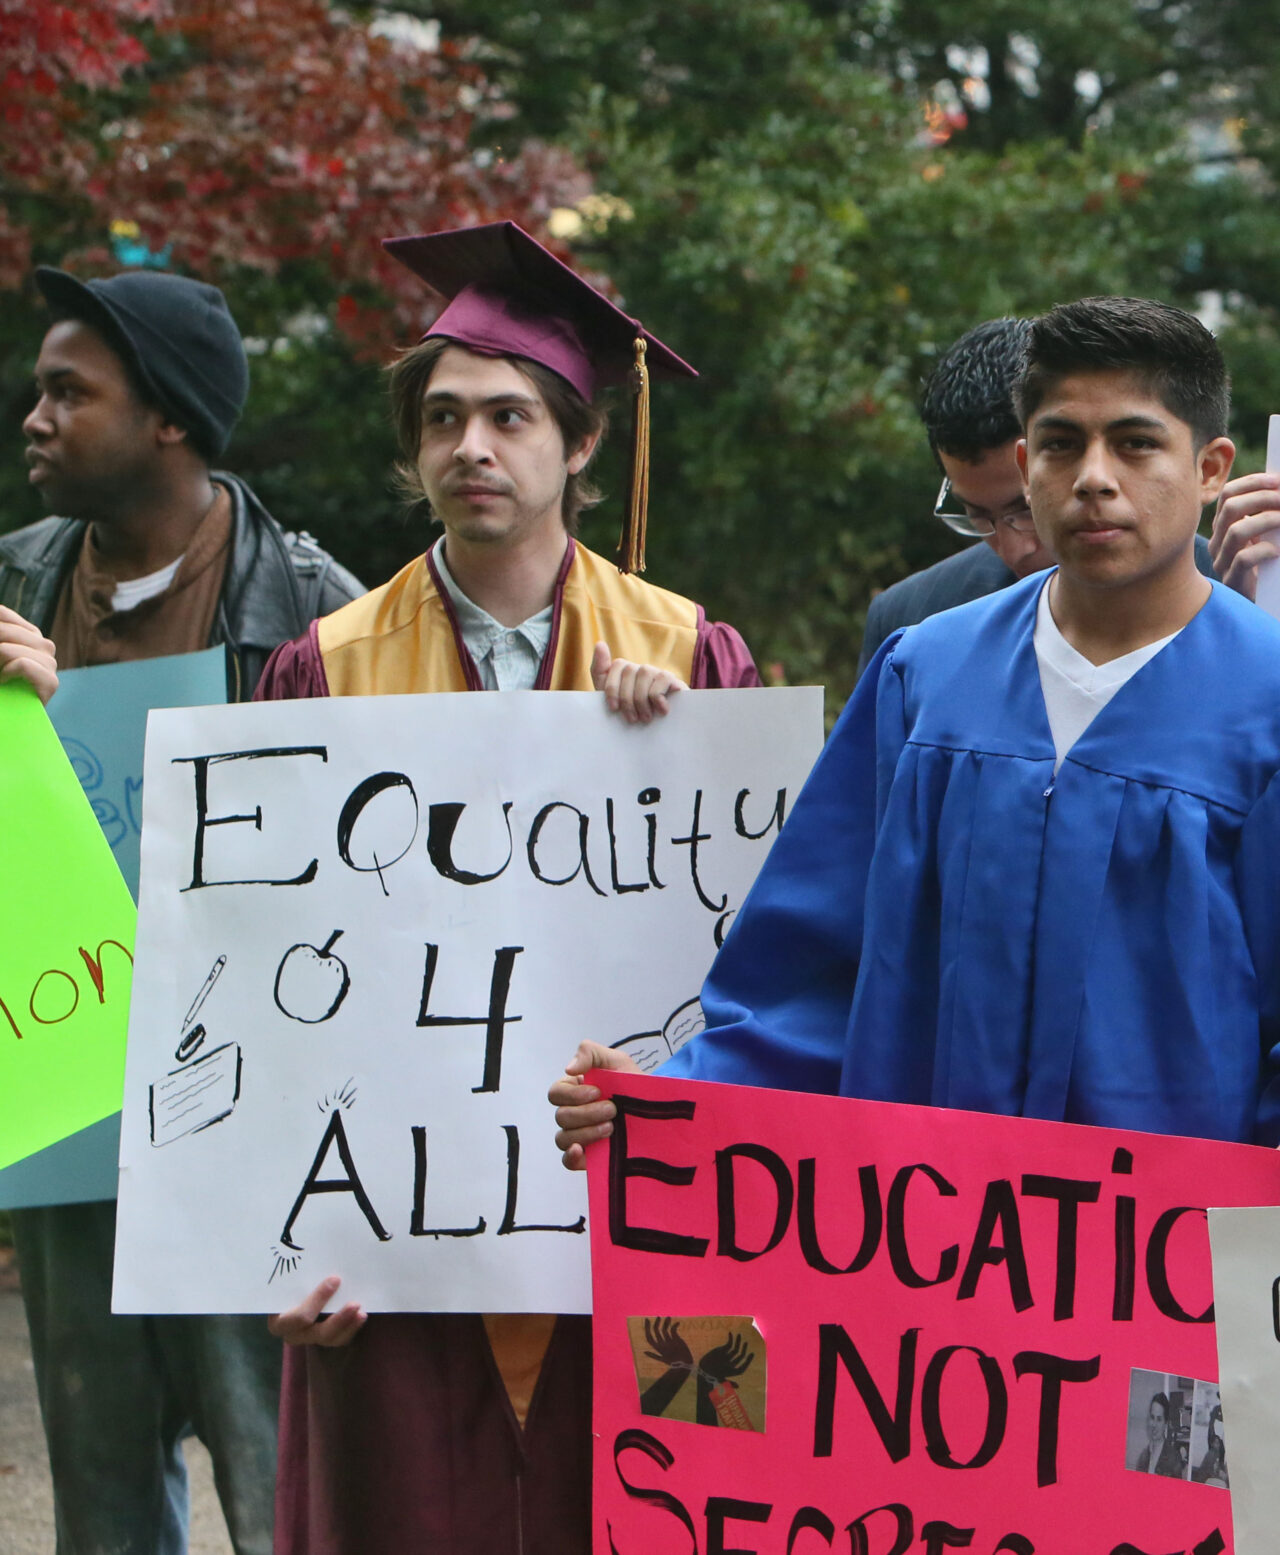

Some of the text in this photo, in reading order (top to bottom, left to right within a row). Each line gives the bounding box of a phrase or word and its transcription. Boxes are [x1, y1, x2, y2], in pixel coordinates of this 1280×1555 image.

[417, 943, 524, 1094] 4
[281, 1109, 586, 1251] ALL
[813, 1322, 1101, 1488] NOT
